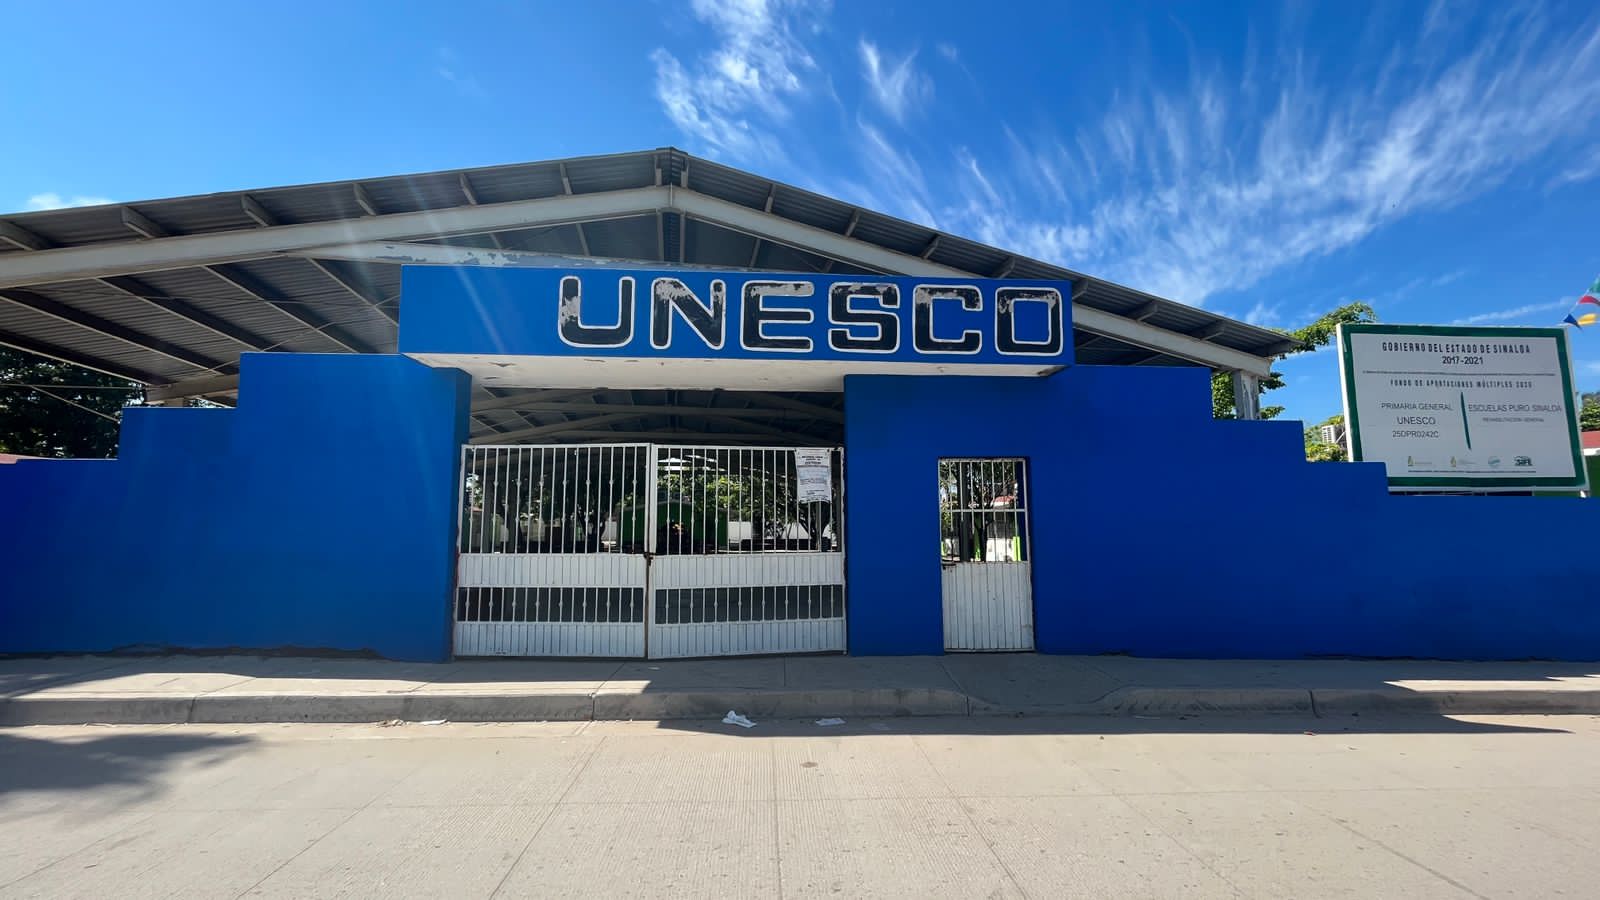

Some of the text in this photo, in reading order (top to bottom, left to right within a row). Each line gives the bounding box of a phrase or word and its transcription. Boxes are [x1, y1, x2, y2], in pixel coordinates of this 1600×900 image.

[557, 274, 1063, 357] UNESCO
[1382, 342, 1531, 353] GOBIERNO DEL ESTADO DE SINALOA
[1442, 356, 1484, 365] 2017-2021
[1426, 380, 1473, 388] APORTACIONES
[1381, 402, 1453, 411] PRIMARIA GENERAL
[1468, 403, 1562, 412] ESCUELAS PURO SINALOA
[1396, 416, 1436, 425] UNESCO
